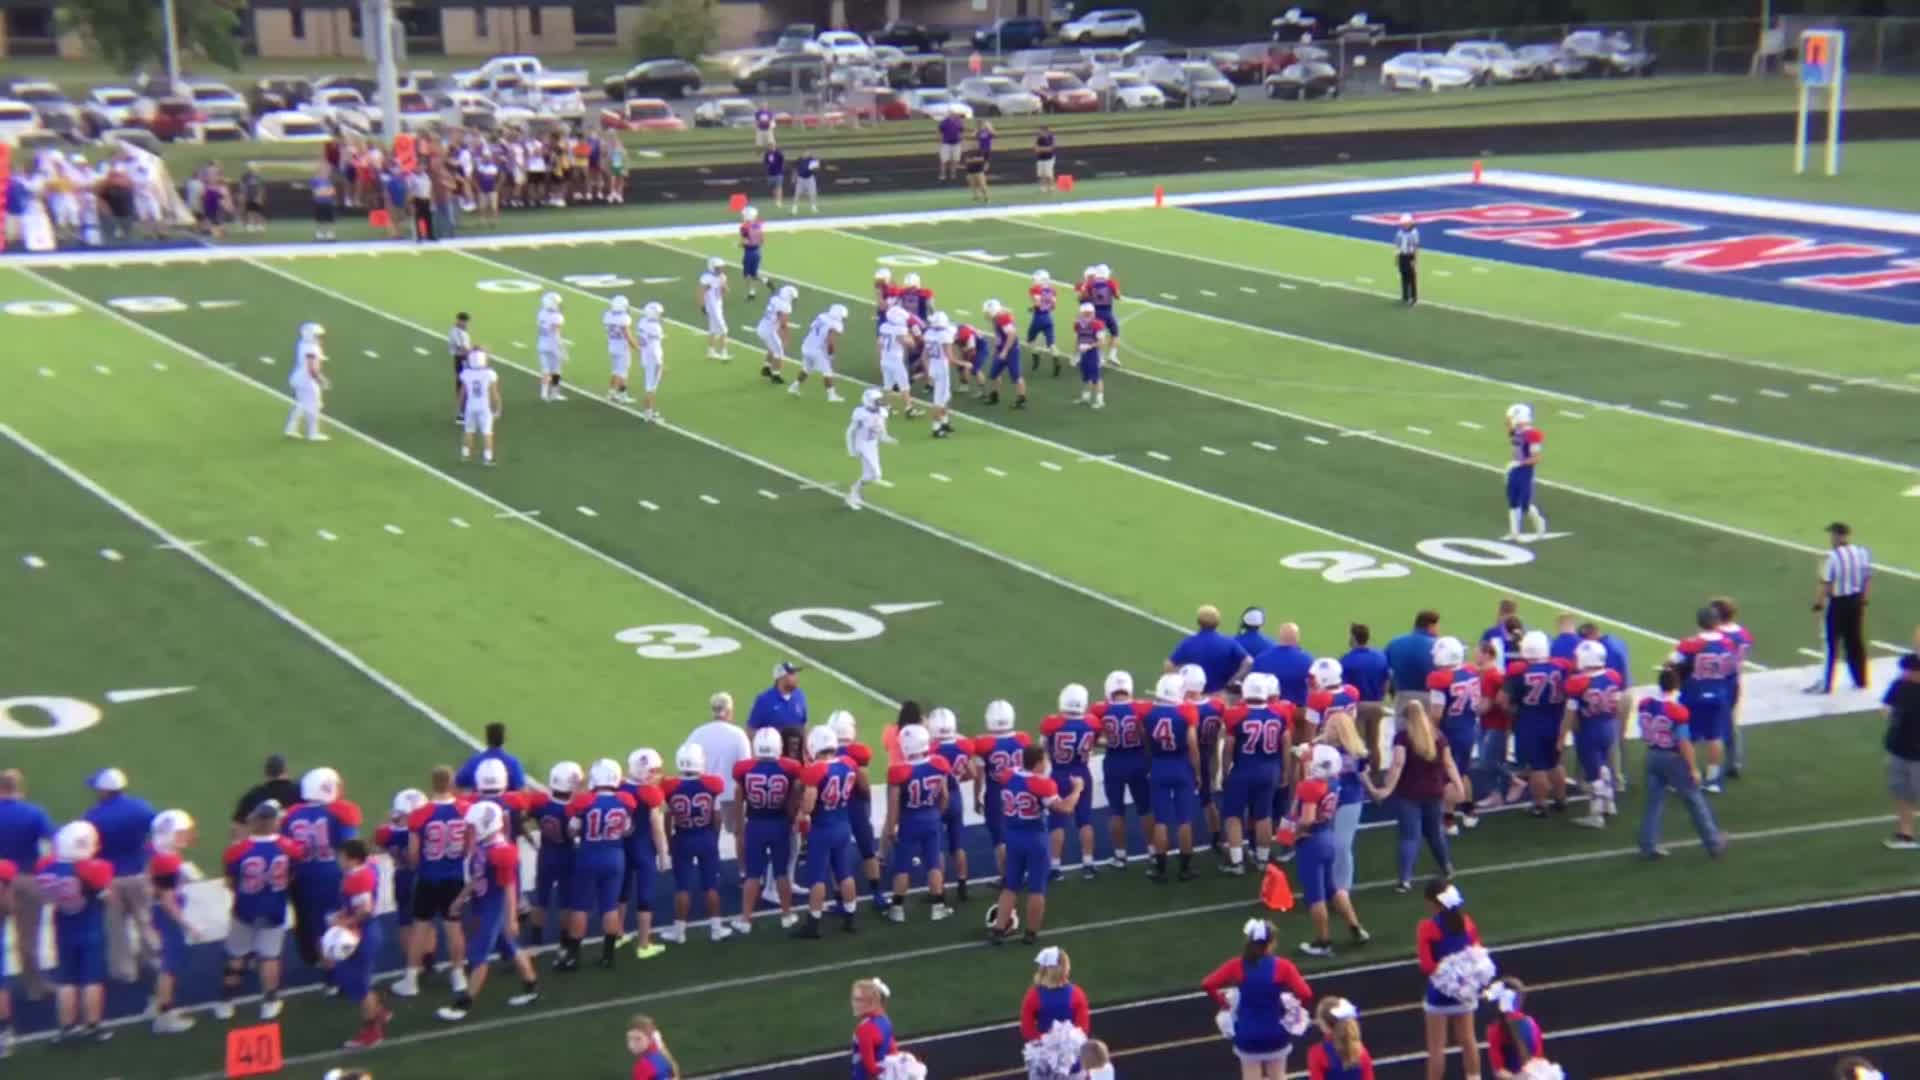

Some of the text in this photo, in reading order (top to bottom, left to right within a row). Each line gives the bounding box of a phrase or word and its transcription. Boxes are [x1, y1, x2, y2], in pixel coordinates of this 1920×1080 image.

[1523, 671, 1562, 706] 71
[1053, 731, 1092, 764] 54
[1151, 717, 1176, 751] 4
[1242, 719, 1281, 756] 70
[743, 773, 788, 810] 52
[584, 808, 625, 842] 12
[237, 1034, 274, 1067] 40
